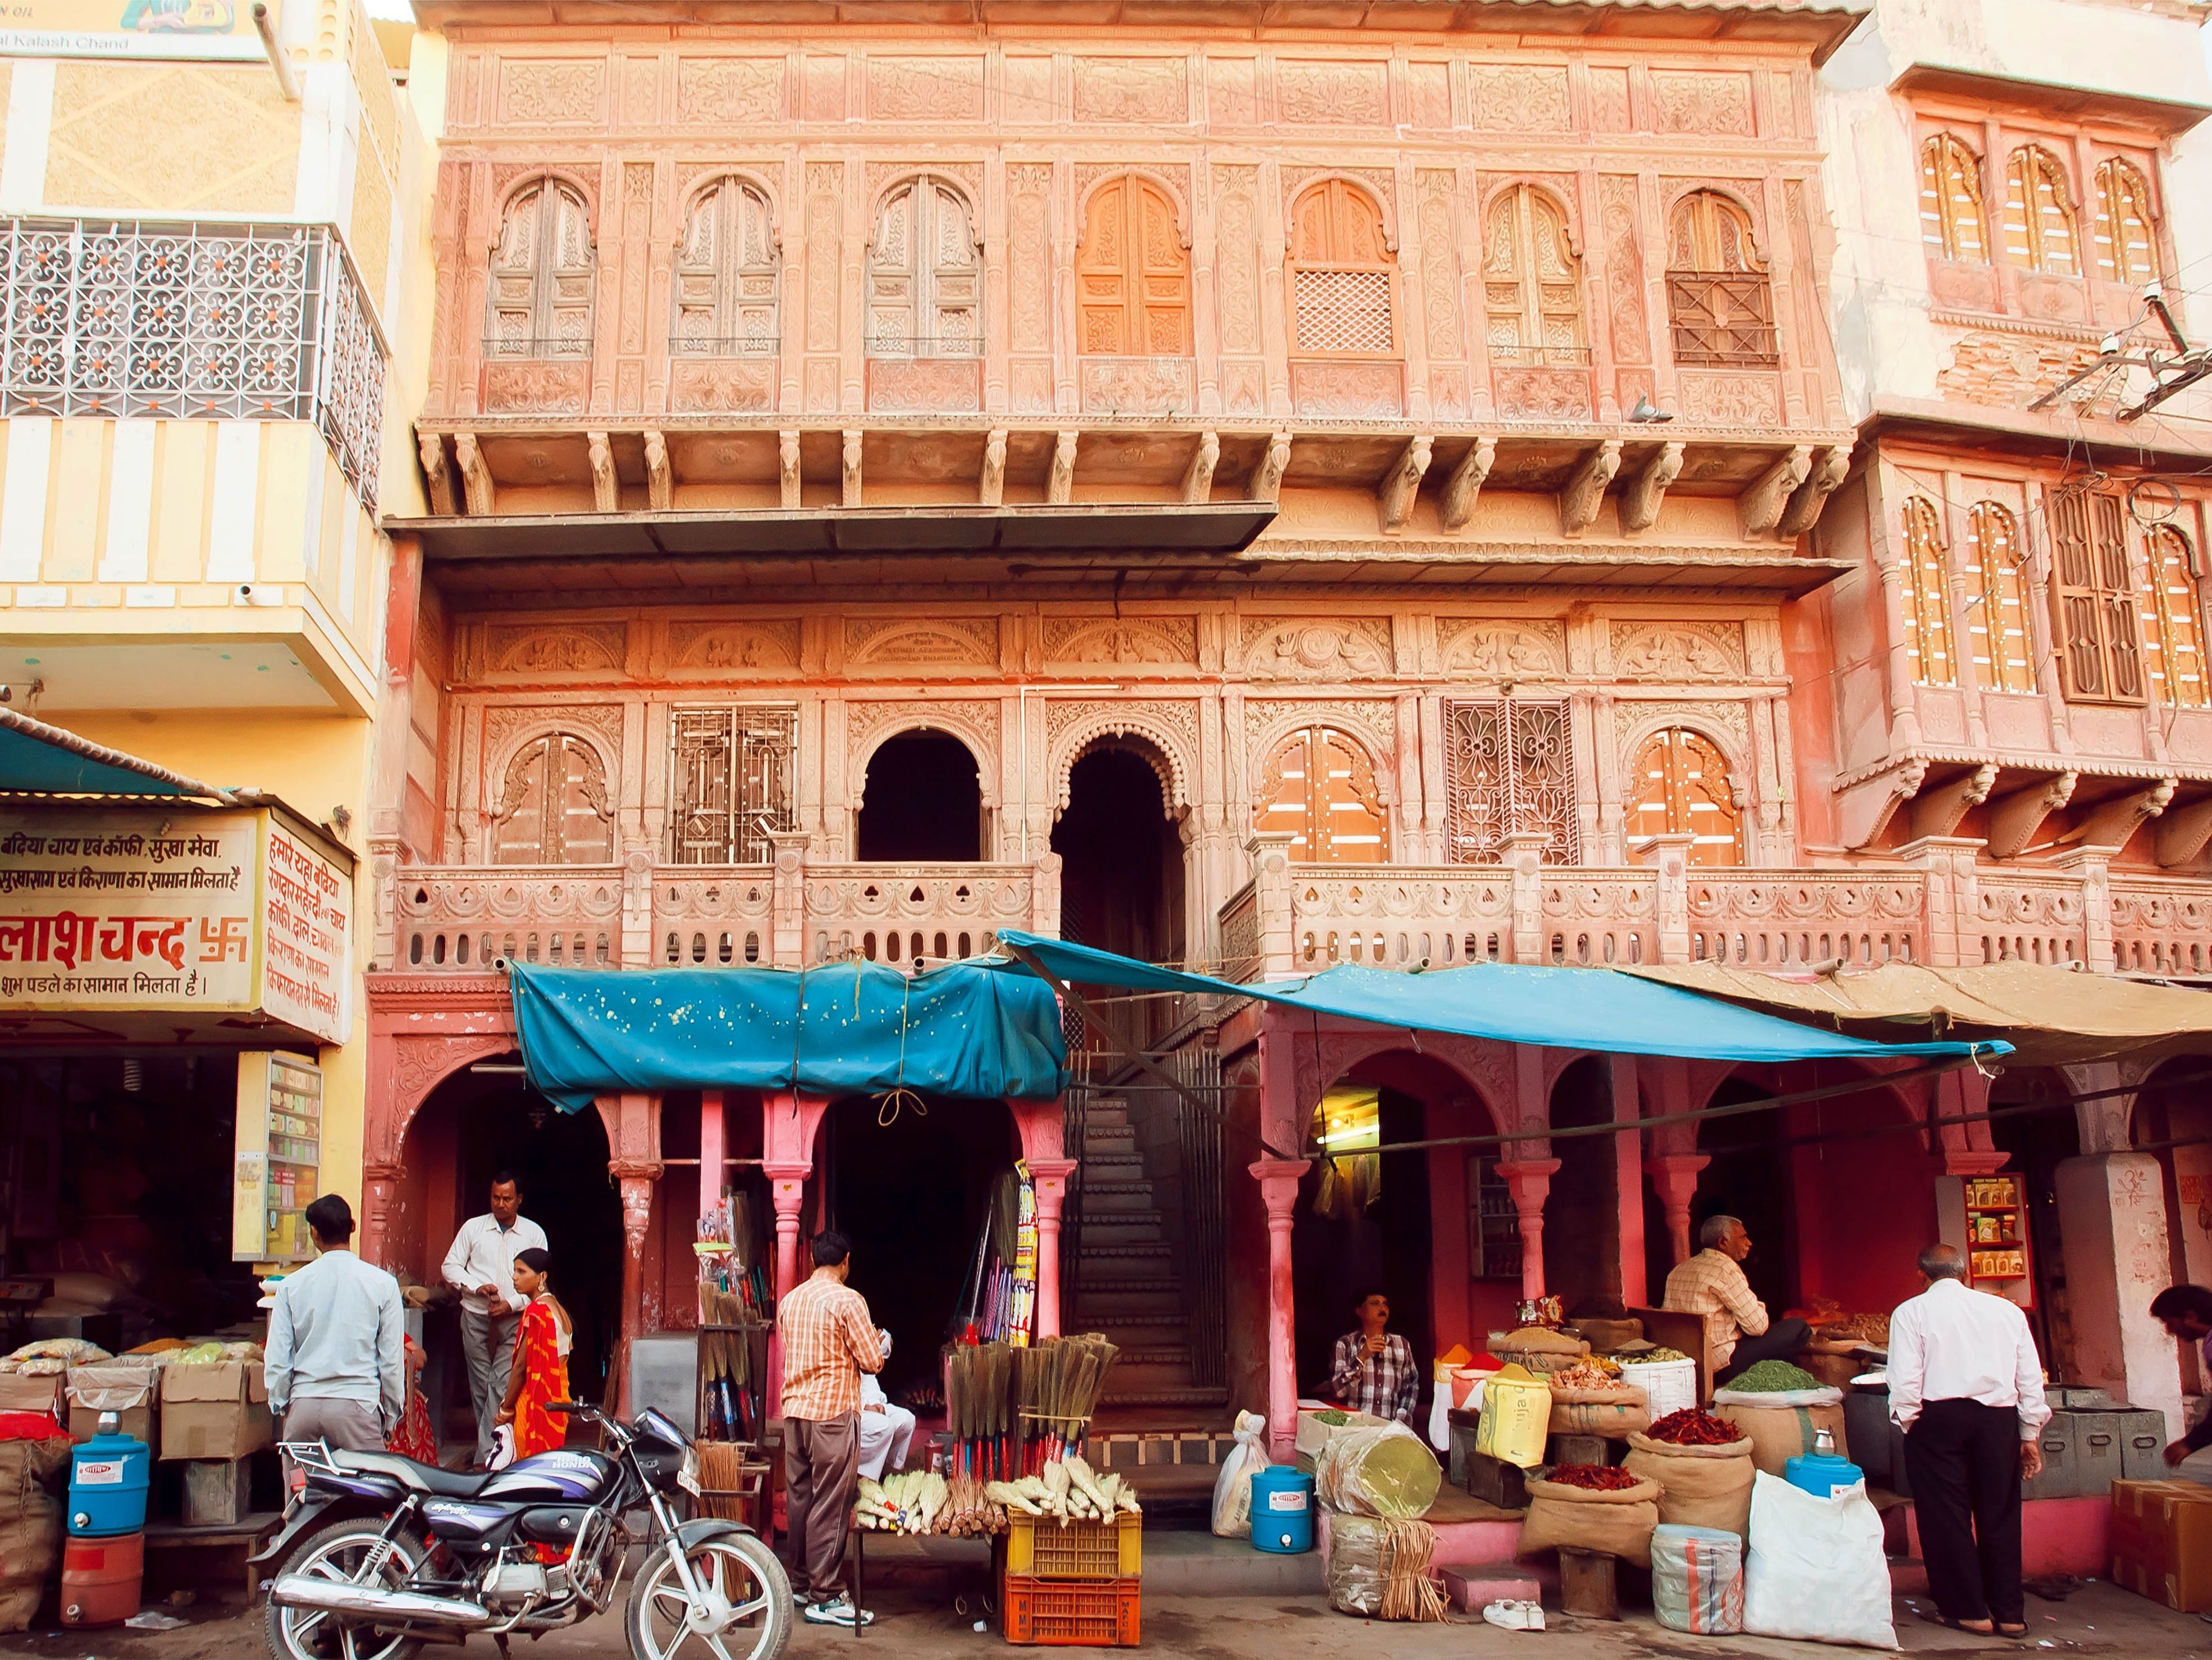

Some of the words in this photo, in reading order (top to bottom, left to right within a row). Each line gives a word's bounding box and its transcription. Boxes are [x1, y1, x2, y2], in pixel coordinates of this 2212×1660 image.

[76, 37, 129, 49] Chand
[48, 838, 81, 856] चाय
[83, 834, 104, 856] एवं
[269, 833, 294, 870] हमारे
[58, 868, 77, 888] एवं
[126, 872, 147, 888] का
[147, 873, 189, 891] सामान
[331, 908, 345, 932] चाय
[99, 916, 192, 971] चन्द
[295, 950, 304, 970] का
[63, 978, 82, 993] का
[83, 978, 129, 993] सामान
[133, 972, 181, 993] मिलता
[312, 981, 332, 1015] मिलता
